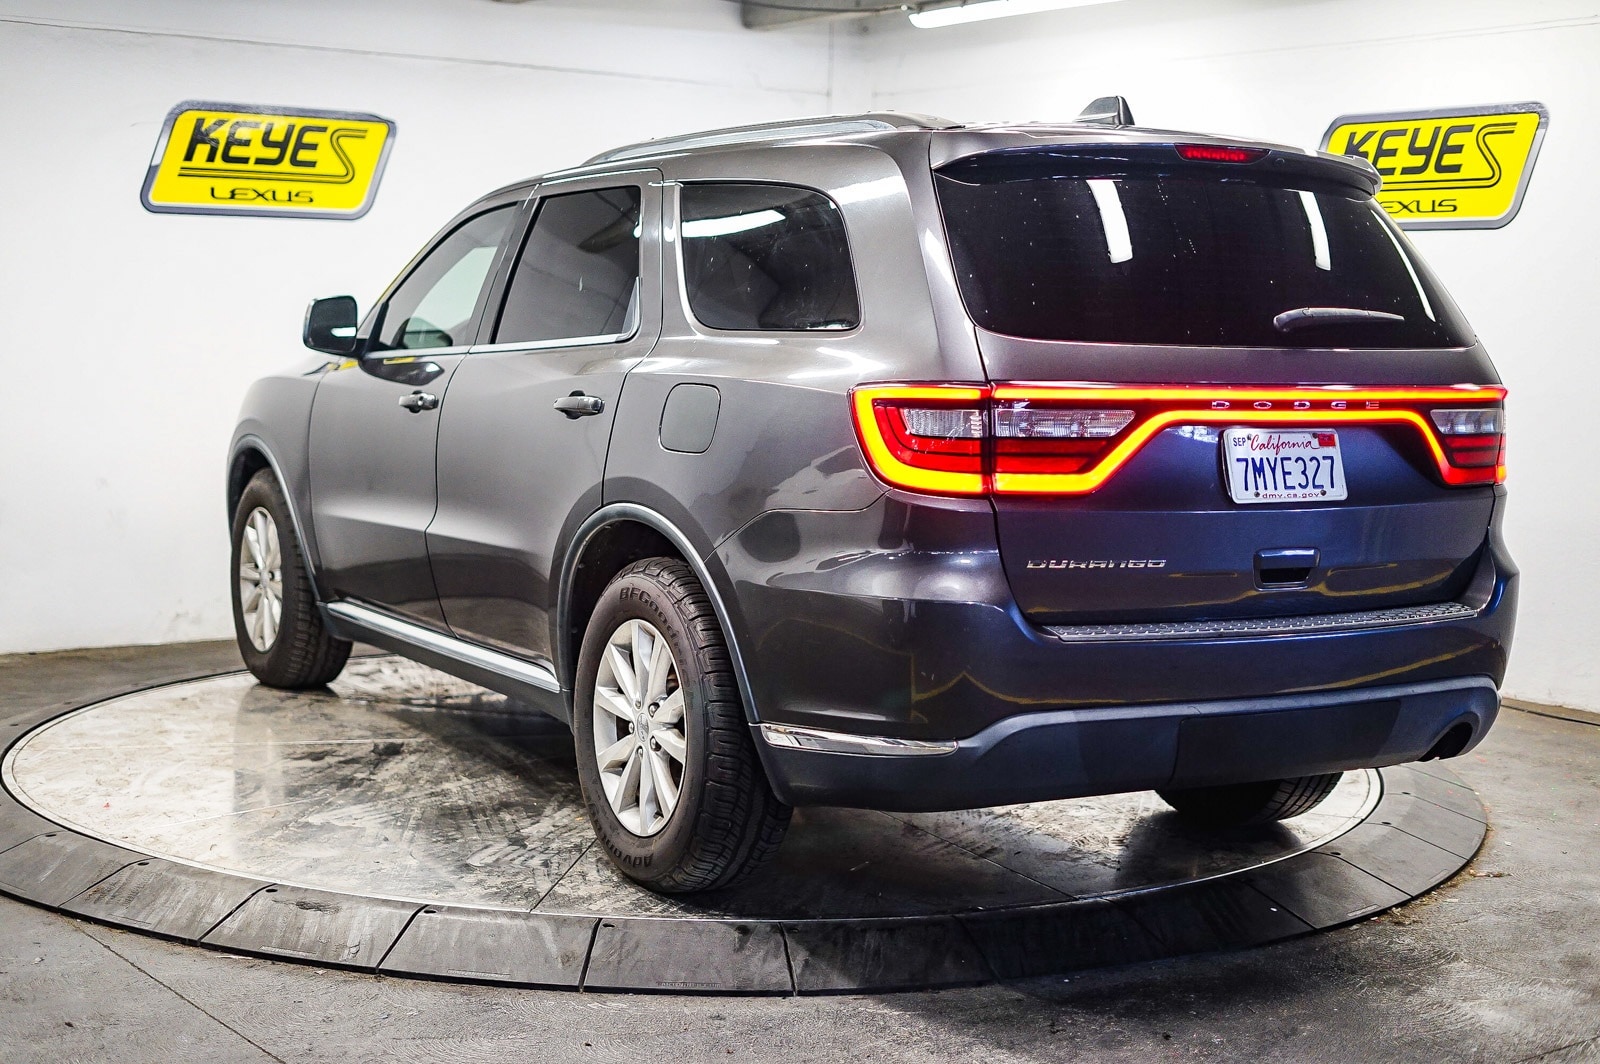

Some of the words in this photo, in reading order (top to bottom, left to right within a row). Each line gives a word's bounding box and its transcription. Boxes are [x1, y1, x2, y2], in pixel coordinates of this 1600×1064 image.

[179, 118, 368, 184] KEYES
[210, 187, 314, 203] LEXUS
[1381, 199, 1458, 214] EXUS
[1211, 400, 1380, 410] DODGE
[1233, 437, 1247, 447] SEP
[1250, 433, 1319, 455] California
[1236, 455, 1335, 491] 7MYE327
[1262, 491, 1320, 499] dmv.ca.gov
[1026, 559, 1167, 569] DURANGO
